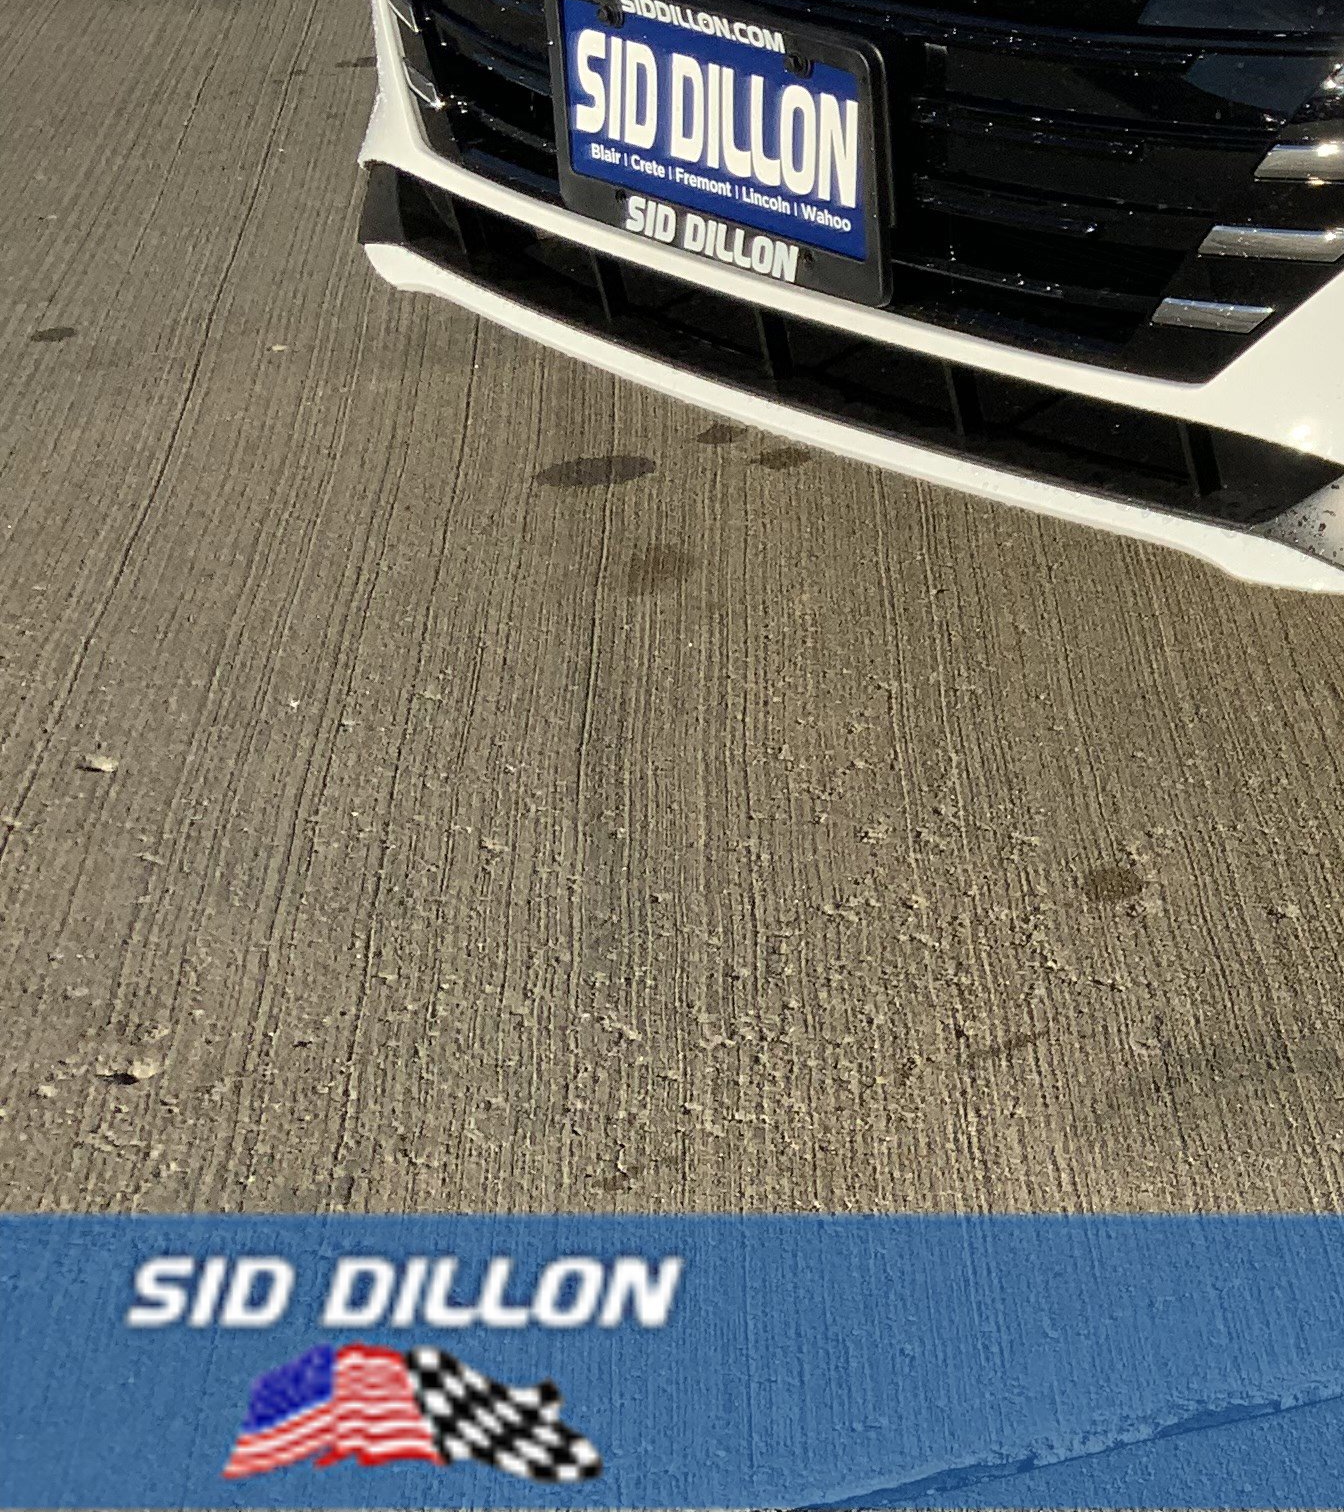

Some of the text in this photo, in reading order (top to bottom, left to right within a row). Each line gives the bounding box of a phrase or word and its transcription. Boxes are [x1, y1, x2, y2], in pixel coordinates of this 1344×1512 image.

[575, 28, 859, 209] SID DILLON
[591, 143, 852, 232] Blair Crete Fremont Lincoln Wahoo
[625, 195, 799, 283] SID DILLON
